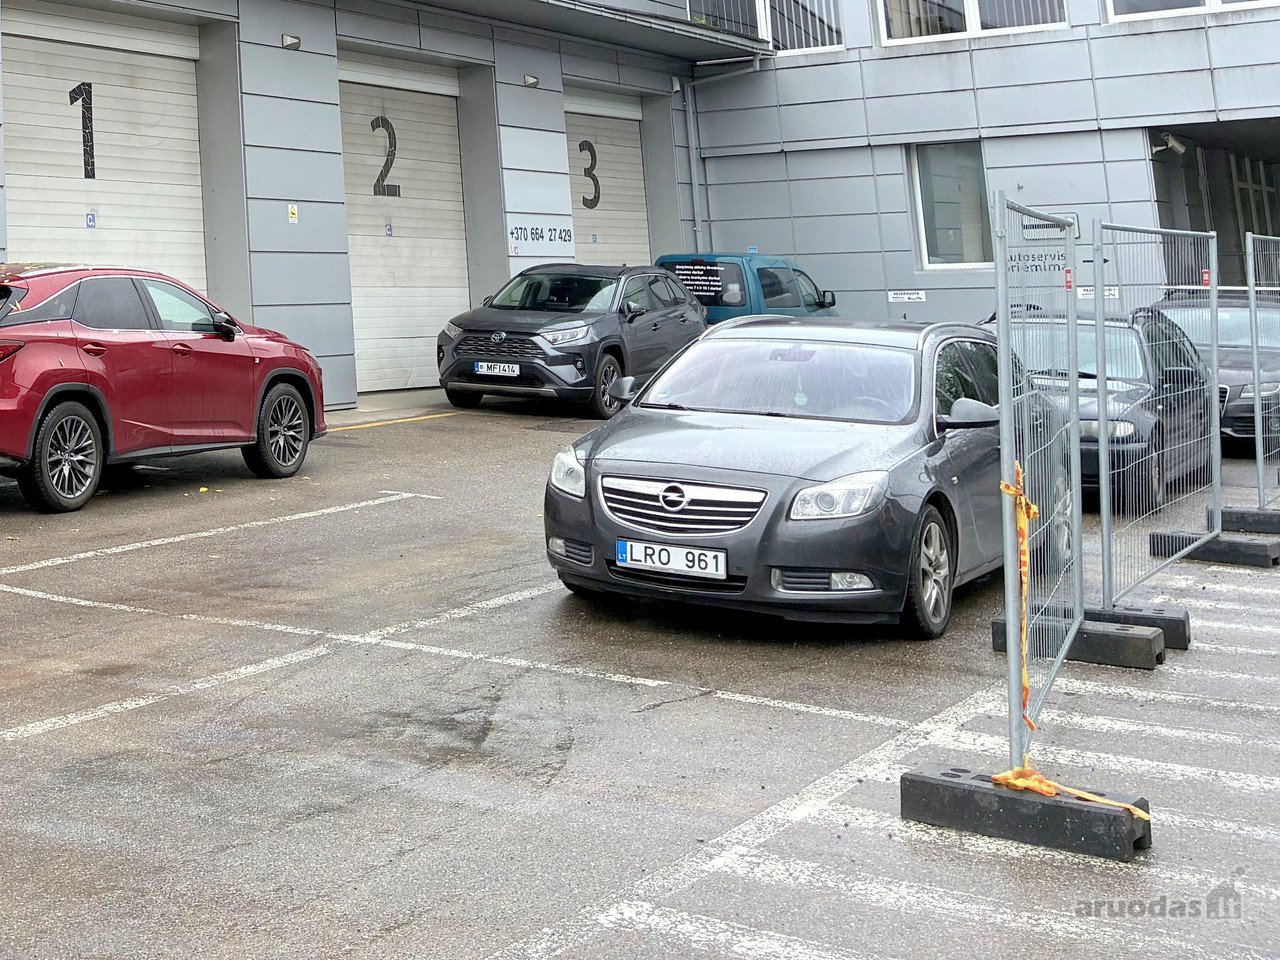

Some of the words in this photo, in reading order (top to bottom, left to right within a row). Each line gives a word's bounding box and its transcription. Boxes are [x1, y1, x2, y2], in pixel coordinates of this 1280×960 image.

[68, 82, 96, 179] 1
[370, 115, 401, 197] 2
[579, 140, 600, 209] 3
[510, 227, 528, 241] +370
[530, 227, 545, 241] 664
[548, 228, 557, 242] 27
[558, 228, 572, 242] 429
[1007, 251, 1067, 262] utoservis
[629, 544, 671, 566] LRO
[685, 551, 719, 573] 961
